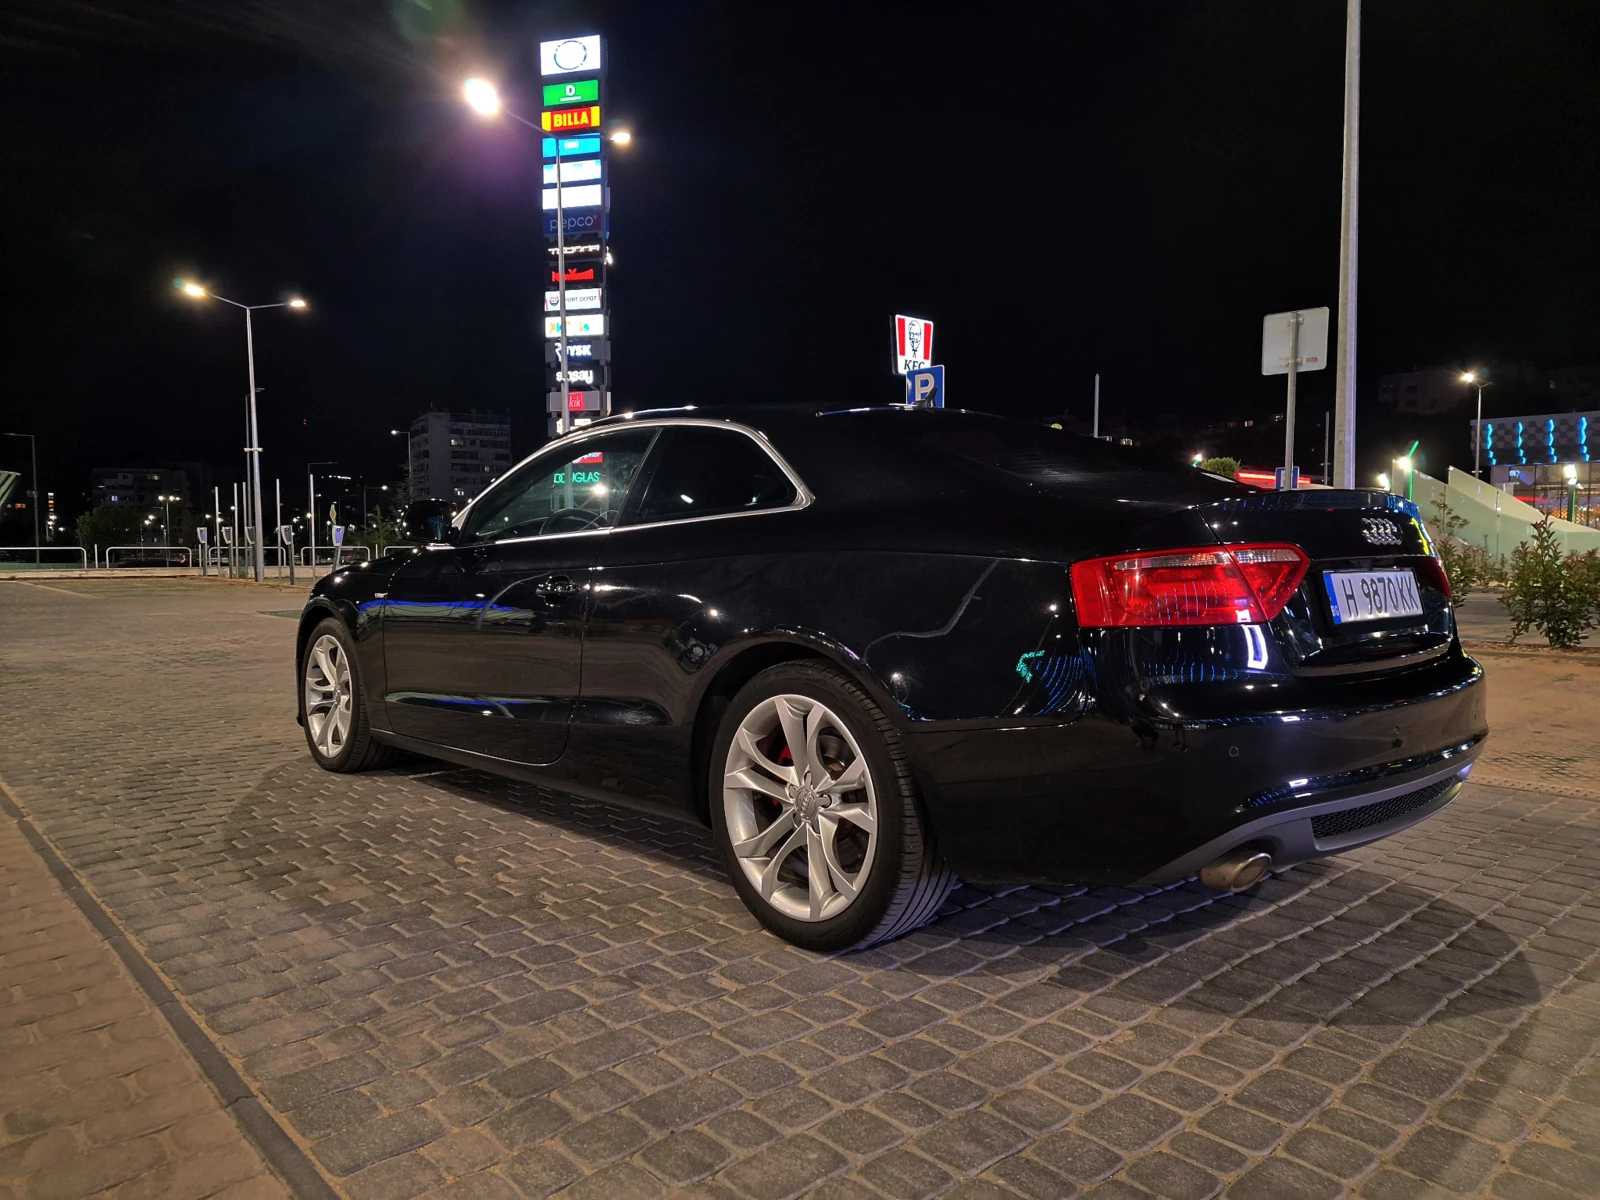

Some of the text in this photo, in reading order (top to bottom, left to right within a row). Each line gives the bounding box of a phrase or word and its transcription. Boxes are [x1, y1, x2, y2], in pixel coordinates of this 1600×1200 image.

[553, 111, 589, 128] BILLA
[549, 215, 593, 231] pepco
[579, 295, 597, 303] DEPOT
[904, 359, 925, 371] KFC
[915, 373, 935, 402] P
[1341, 578, 1359, 617] H
